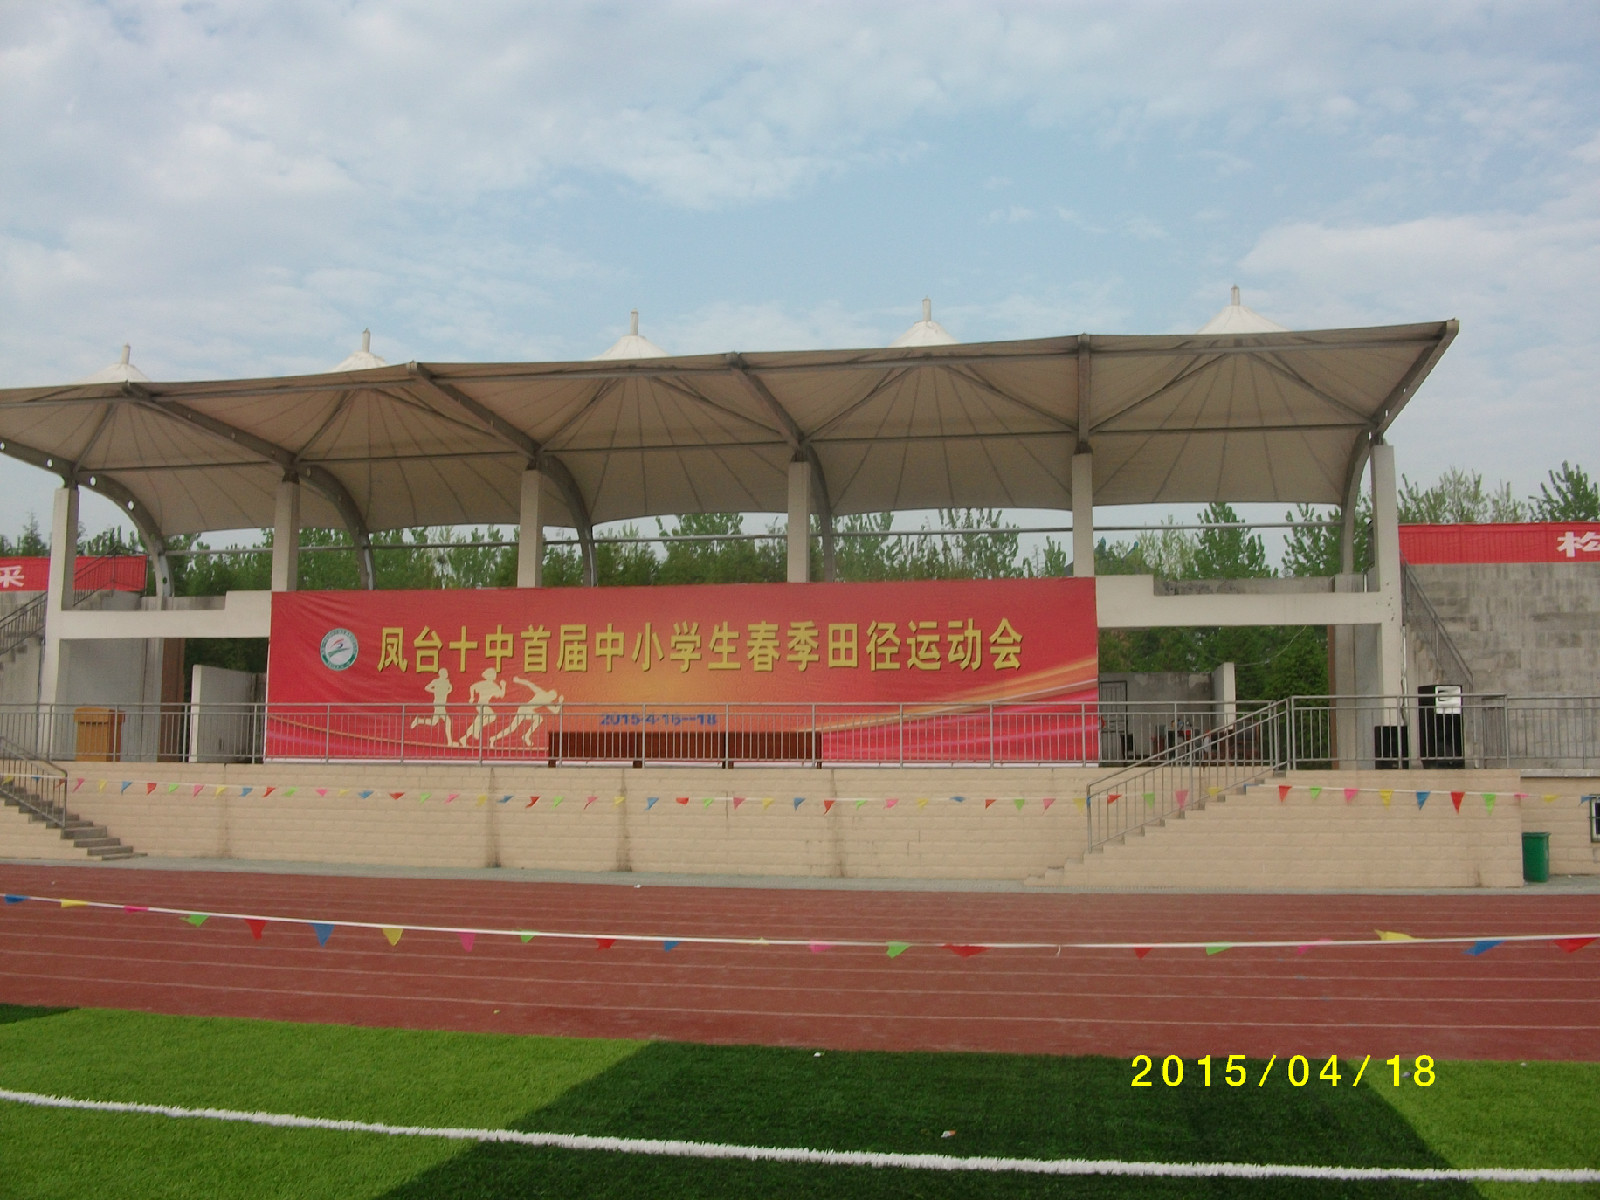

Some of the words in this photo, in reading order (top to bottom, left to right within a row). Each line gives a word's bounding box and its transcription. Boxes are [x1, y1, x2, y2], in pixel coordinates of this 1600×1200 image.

[377, 617, 1023, 673] 凤台十中首届中小学生春季田径运动会
